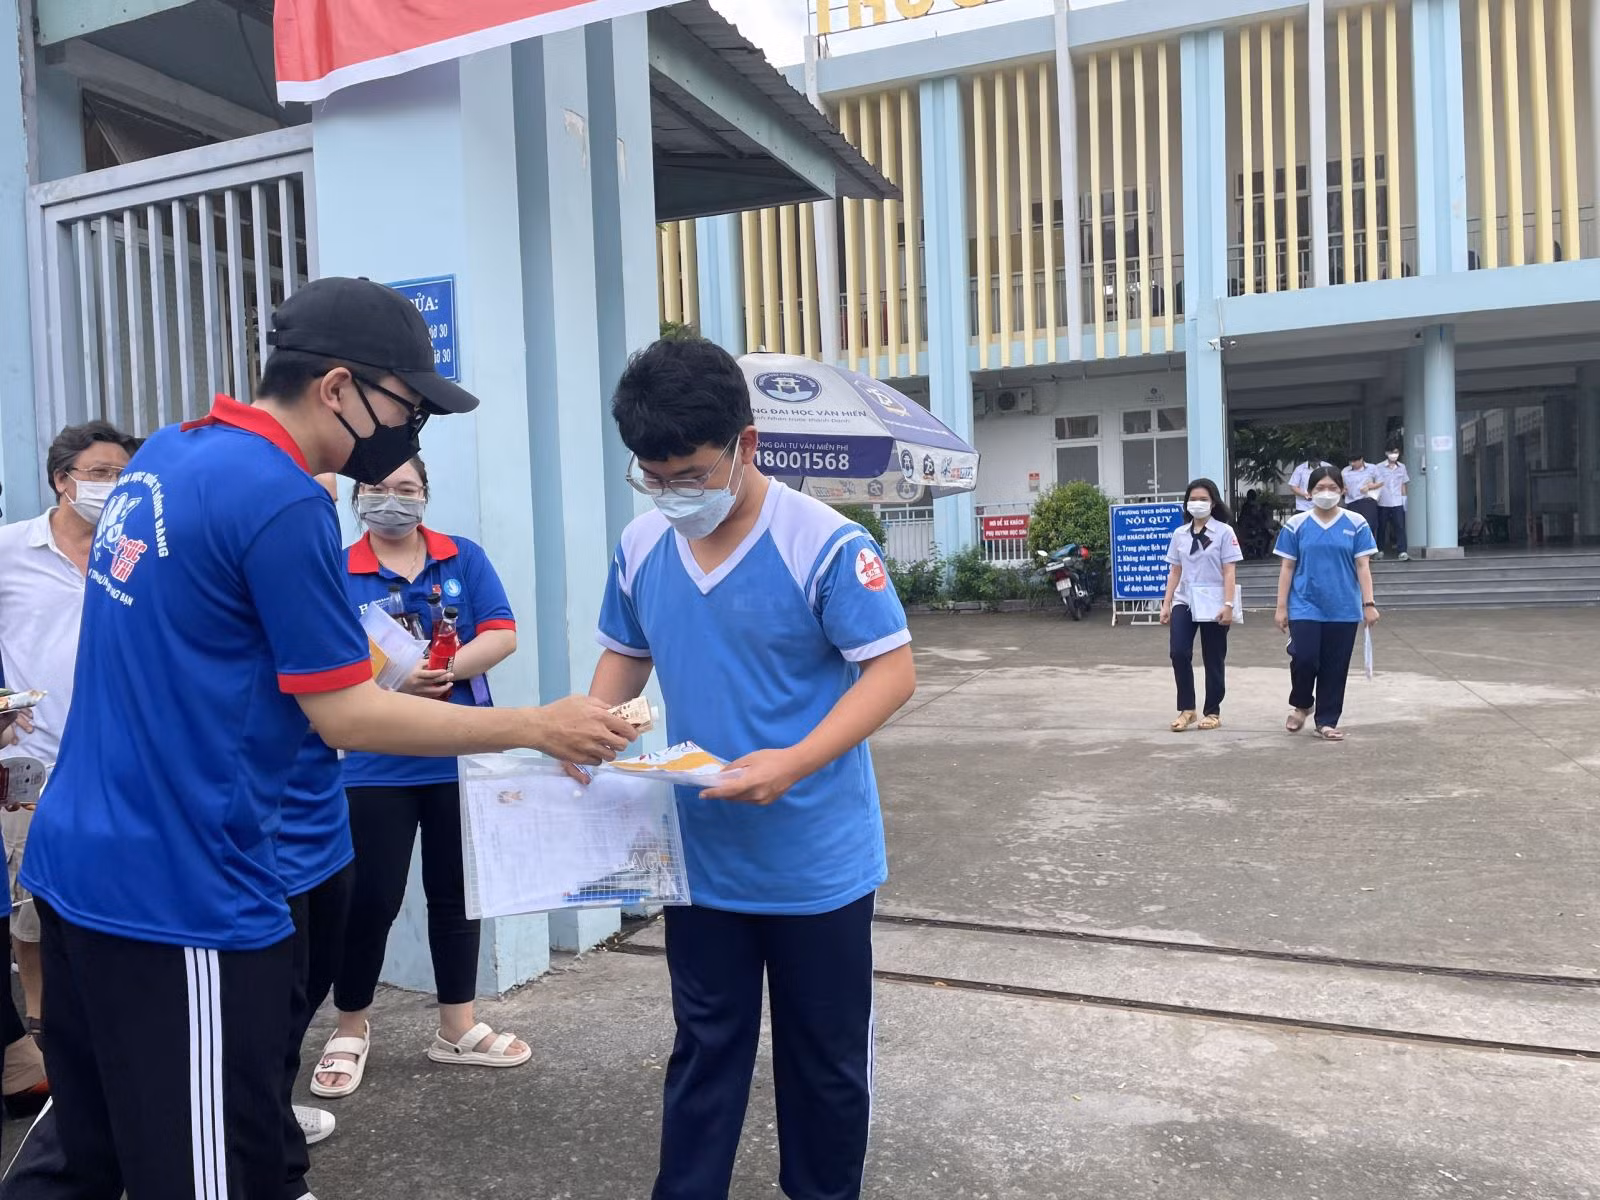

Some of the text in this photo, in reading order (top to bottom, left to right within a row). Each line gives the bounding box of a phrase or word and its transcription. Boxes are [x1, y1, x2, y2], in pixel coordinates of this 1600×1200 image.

[409, 292, 439, 312] ỬA:
[439, 323, 448, 338] 30
[442, 348, 451, 363] 30
[755, 450, 850, 471] 18001568
[1125, 516, 1172, 525] NỘI QUY
[154, 518, 169, 558] BÀNG
